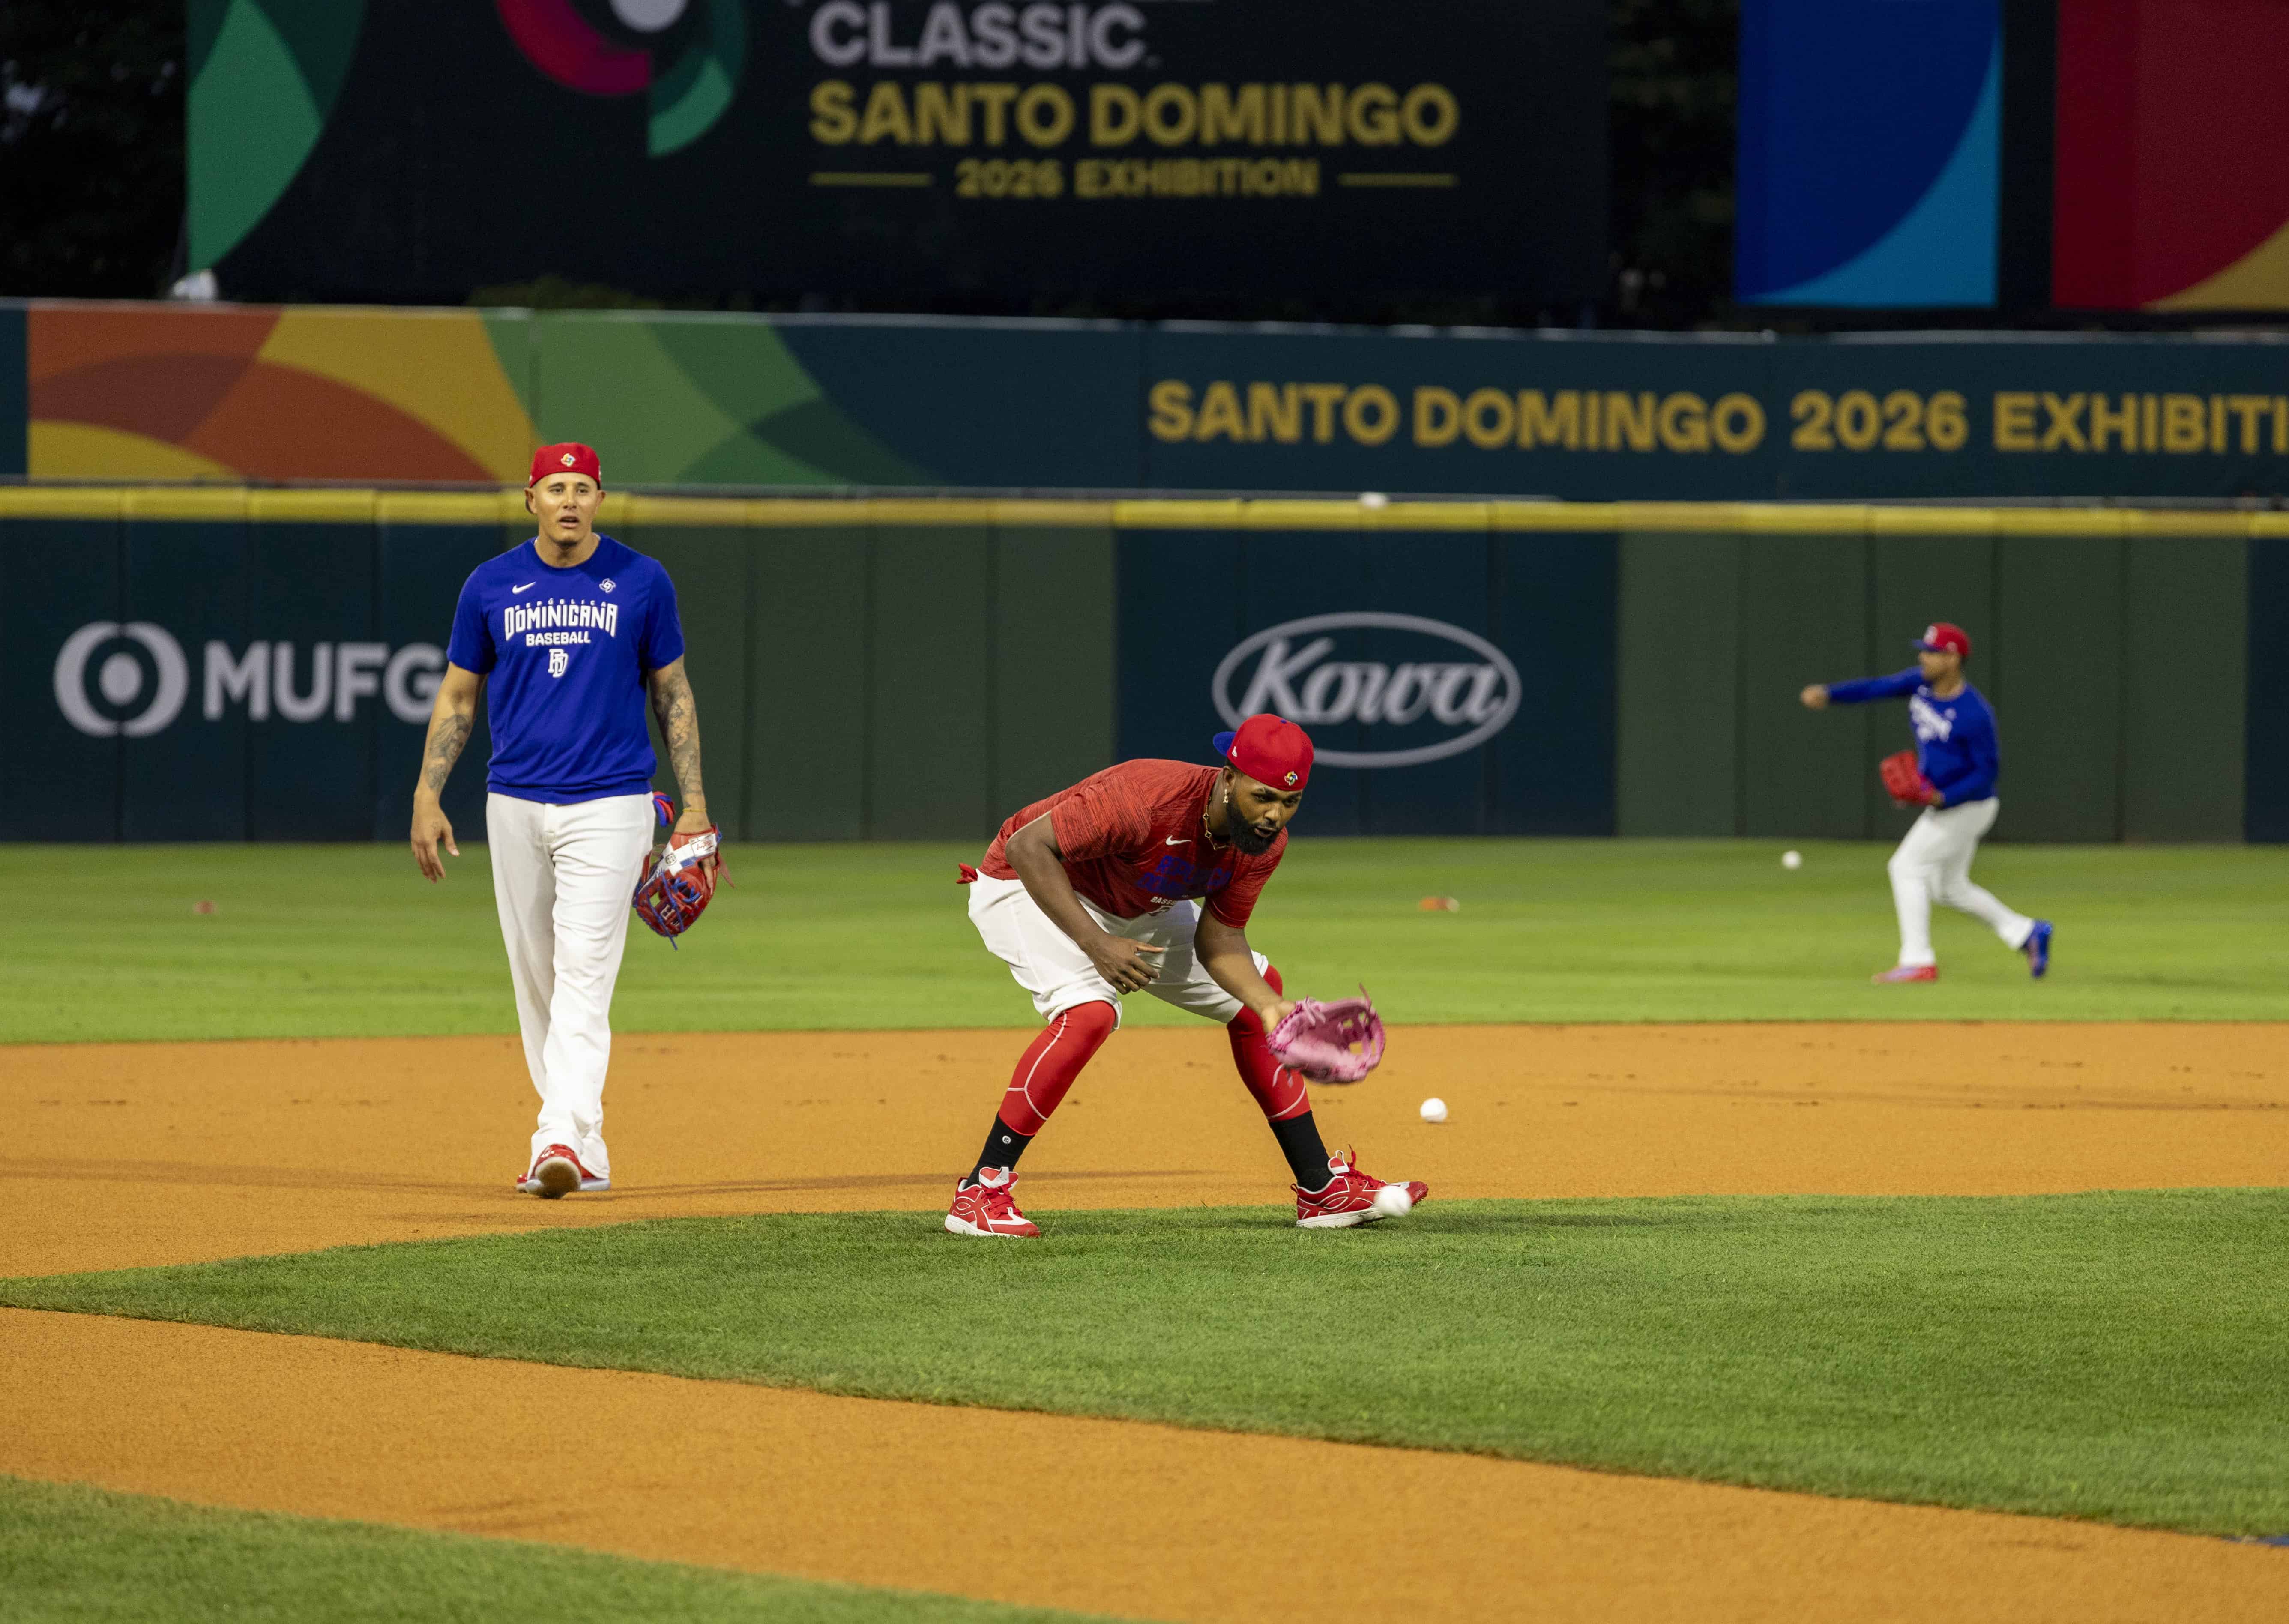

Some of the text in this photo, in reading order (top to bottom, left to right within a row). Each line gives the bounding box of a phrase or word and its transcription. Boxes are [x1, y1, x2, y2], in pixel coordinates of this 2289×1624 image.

[809, 2, 1146, 69] CLASSIC
[809, 81, 1459, 147] SANTO DOMINGO
[956, 158, 1320, 199] 2026 EXHIBITION
[1149, 380, 1400, 446] SANTO
[1413, 386, 1766, 454] DOMINGO
[1791, 389, 1969, 452] 2026
[504, 602, 618, 641] DOMINICANA
[526, 631, 591, 647] BASEBALL
[203, 640, 445, 725] MUFG
[1239, 638, 1505, 725] Kowa
